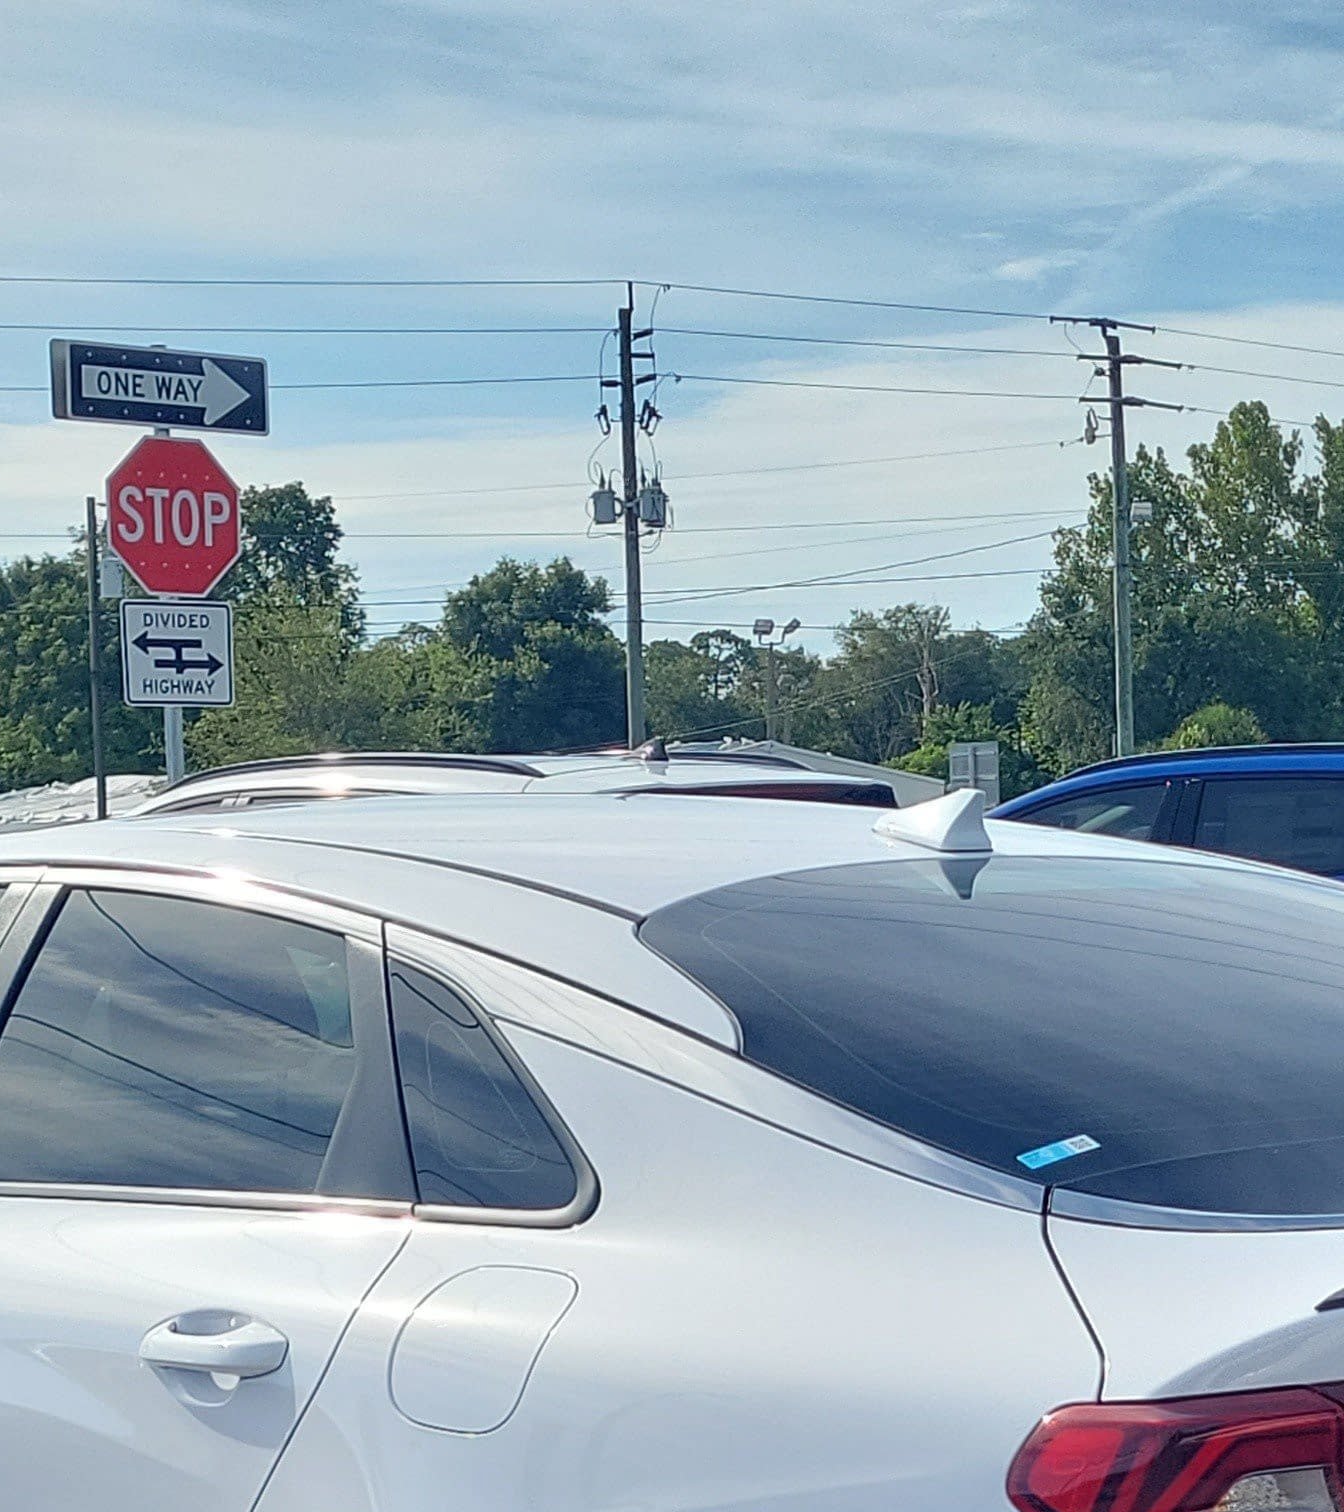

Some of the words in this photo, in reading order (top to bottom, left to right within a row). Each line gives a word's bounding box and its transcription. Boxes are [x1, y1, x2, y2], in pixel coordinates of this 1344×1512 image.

[96, 370, 145, 398] ONE
[155, 374, 204, 403] WAY
[117, 485, 231, 547] STOP
[142, 612, 210, 630] DIVIDED
[142, 678, 216, 695] HIGHWAY
